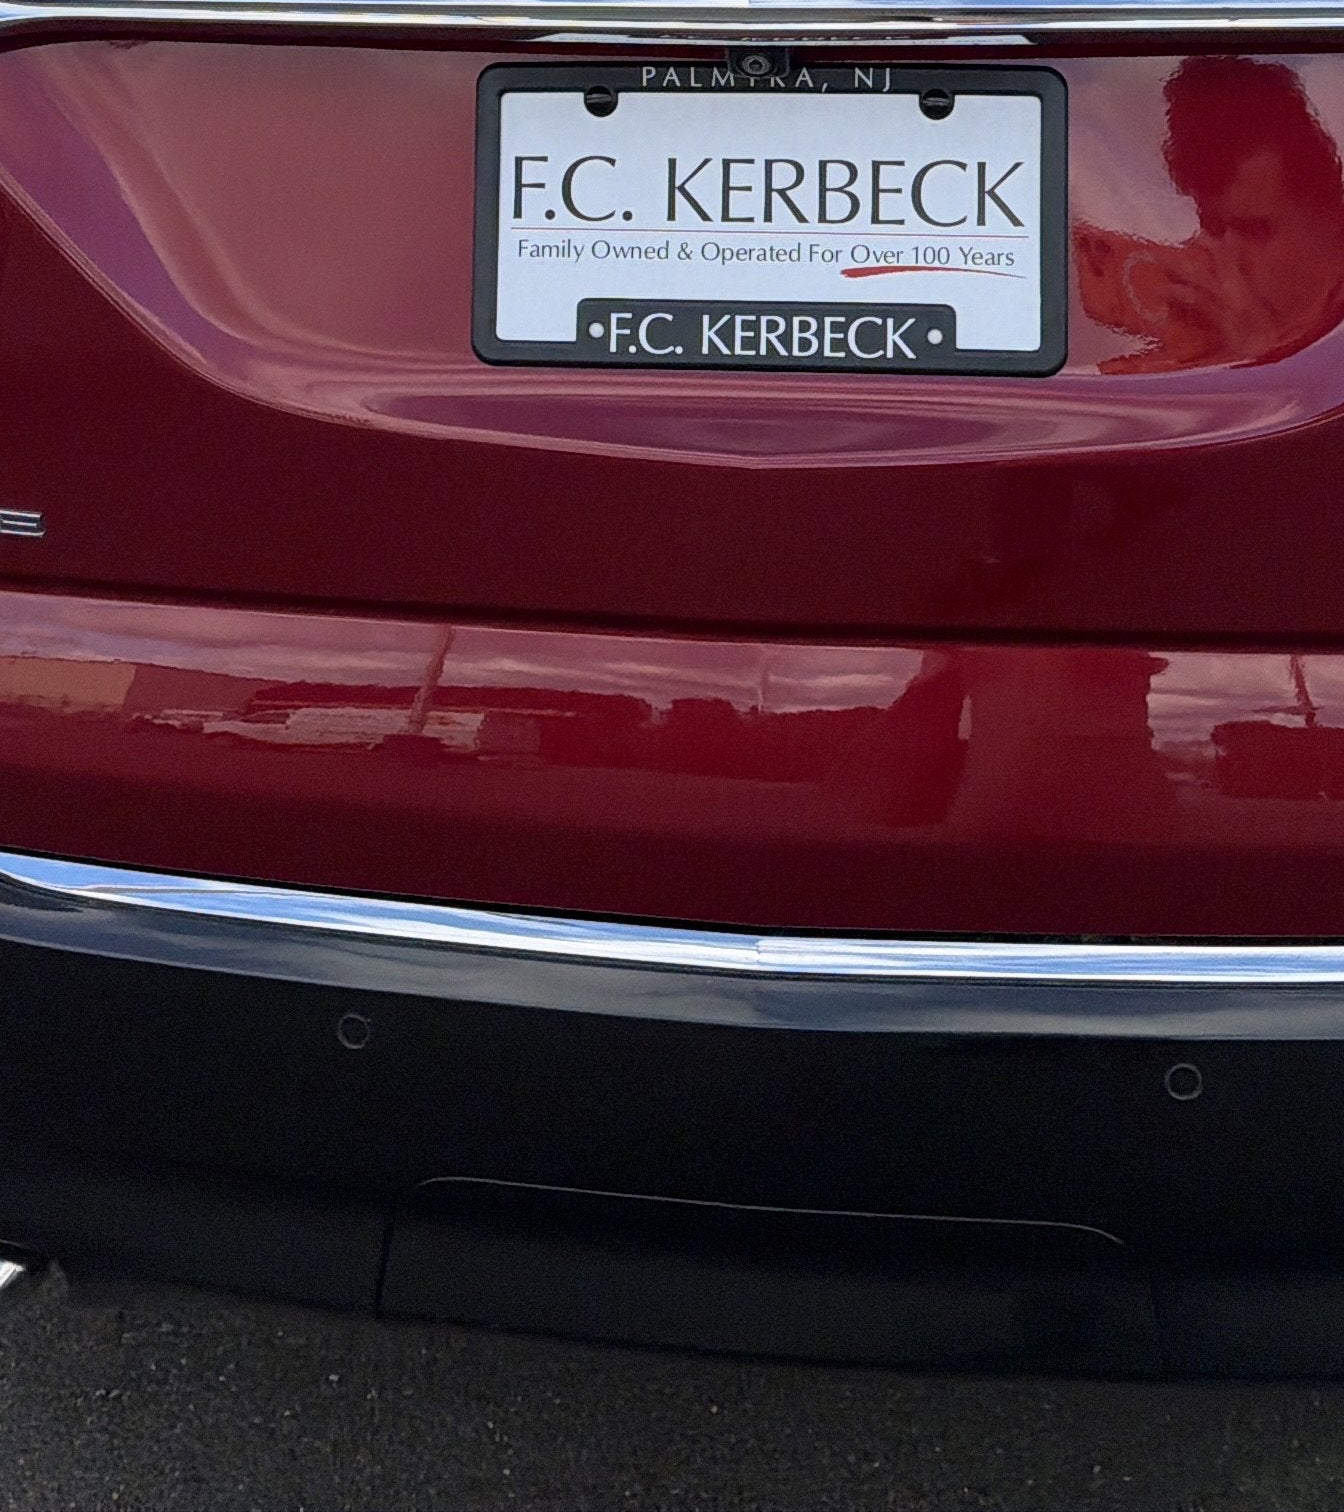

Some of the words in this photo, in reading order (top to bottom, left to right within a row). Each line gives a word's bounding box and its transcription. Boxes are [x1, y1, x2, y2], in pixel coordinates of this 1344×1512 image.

[854, 67, 892, 92] NJ
[512, 154, 634, 222] F.C.
[666, 157, 1025, 228] KERBECK
[518, 238, 584, 265] Family
[591, 238, 670, 262] Owned
[677, 242, 693, 262] &
[701, 241, 801, 266] Operated
[810, 243, 843, 265] For
[850, 245, 904, 266] Over
[912, 246, 950, 266] 100
[959, 246, 1015, 268] Years
[608, 312, 683, 356] F.C.
[702, 314, 916, 360] KERBECK
